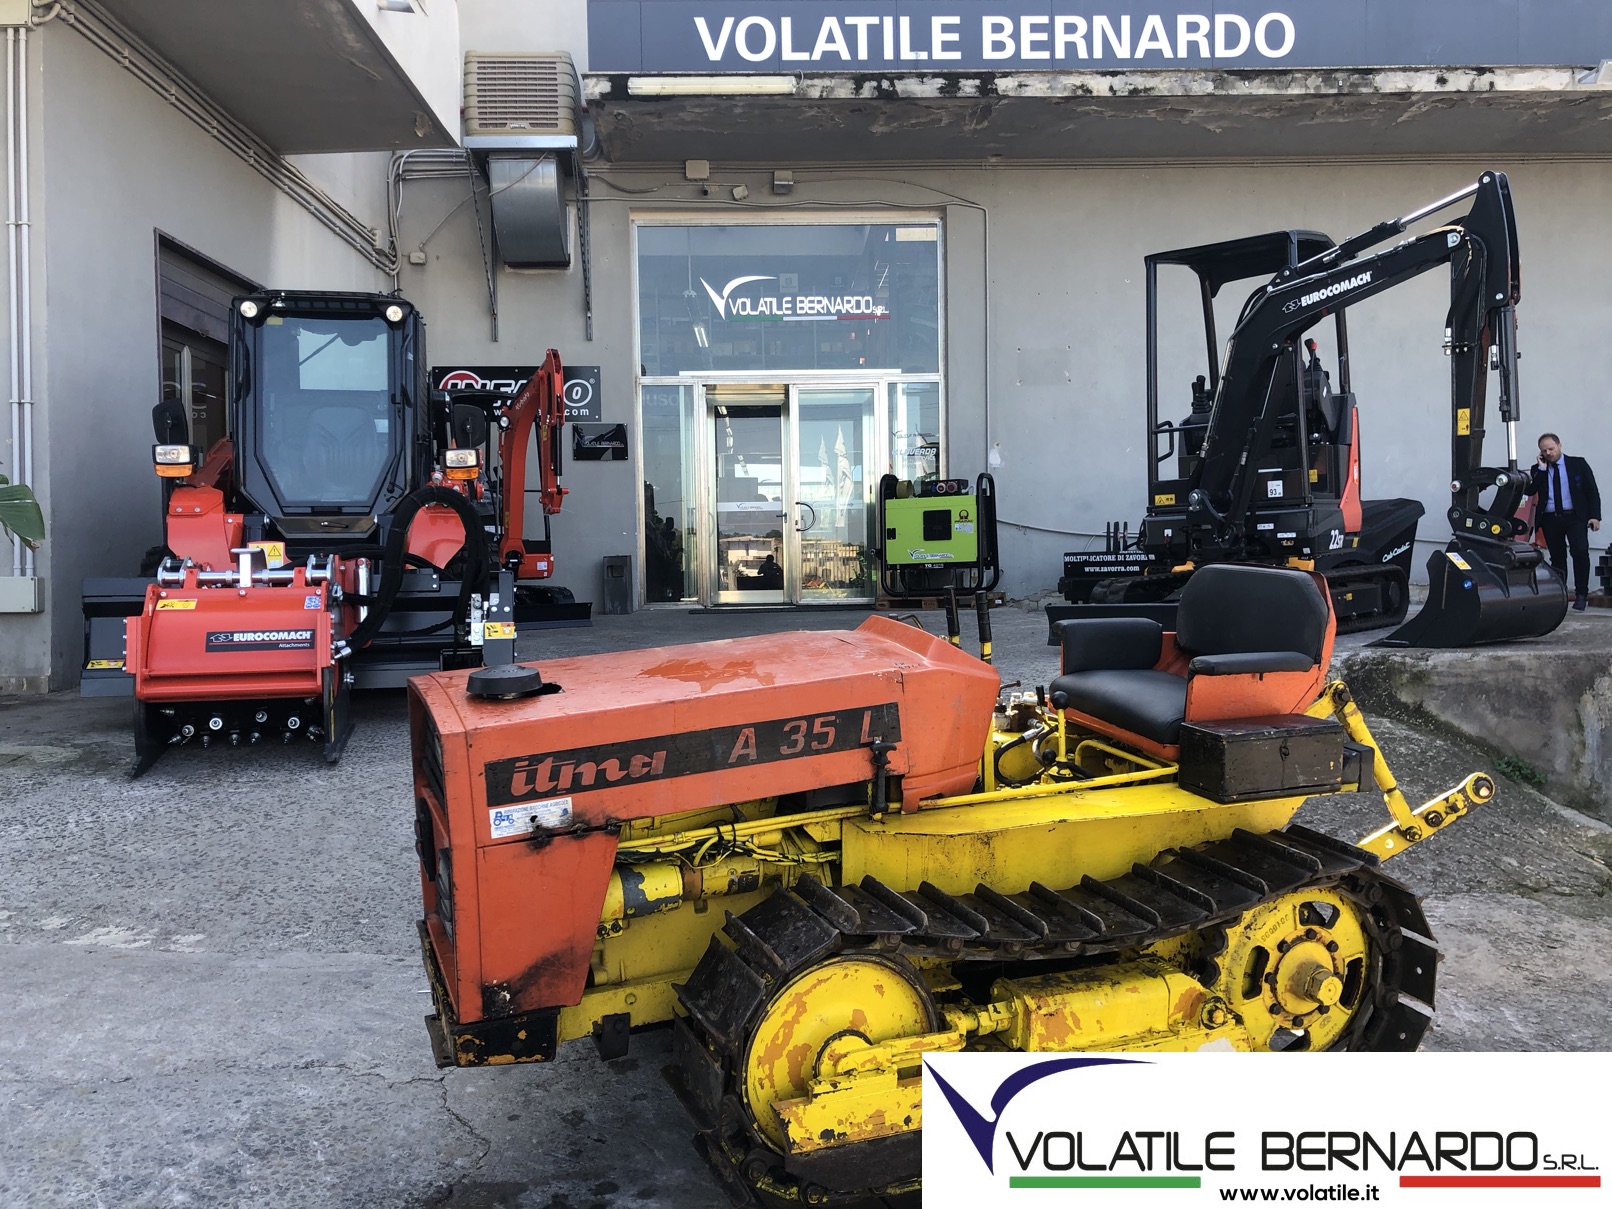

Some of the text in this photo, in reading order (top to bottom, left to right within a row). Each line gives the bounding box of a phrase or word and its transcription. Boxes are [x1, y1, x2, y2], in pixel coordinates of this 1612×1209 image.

[694, 12, 1296, 61] VOLATILE BERNARDO
[1300, 271, 1372, 307] EUROCOMACH
[729, 297, 792, 315] VOLATILE
[796, 296, 872, 314] BERNARDO
[1269, 488, 1277, 496] 93
[1084, 565, 1140, 573] www.zavorra.com
[233, 631, 312, 641] EUROCOMACH
[728, 727, 757, 763] A
[779, 715, 837, 755] 35
[861, 710, 882, 744] L
